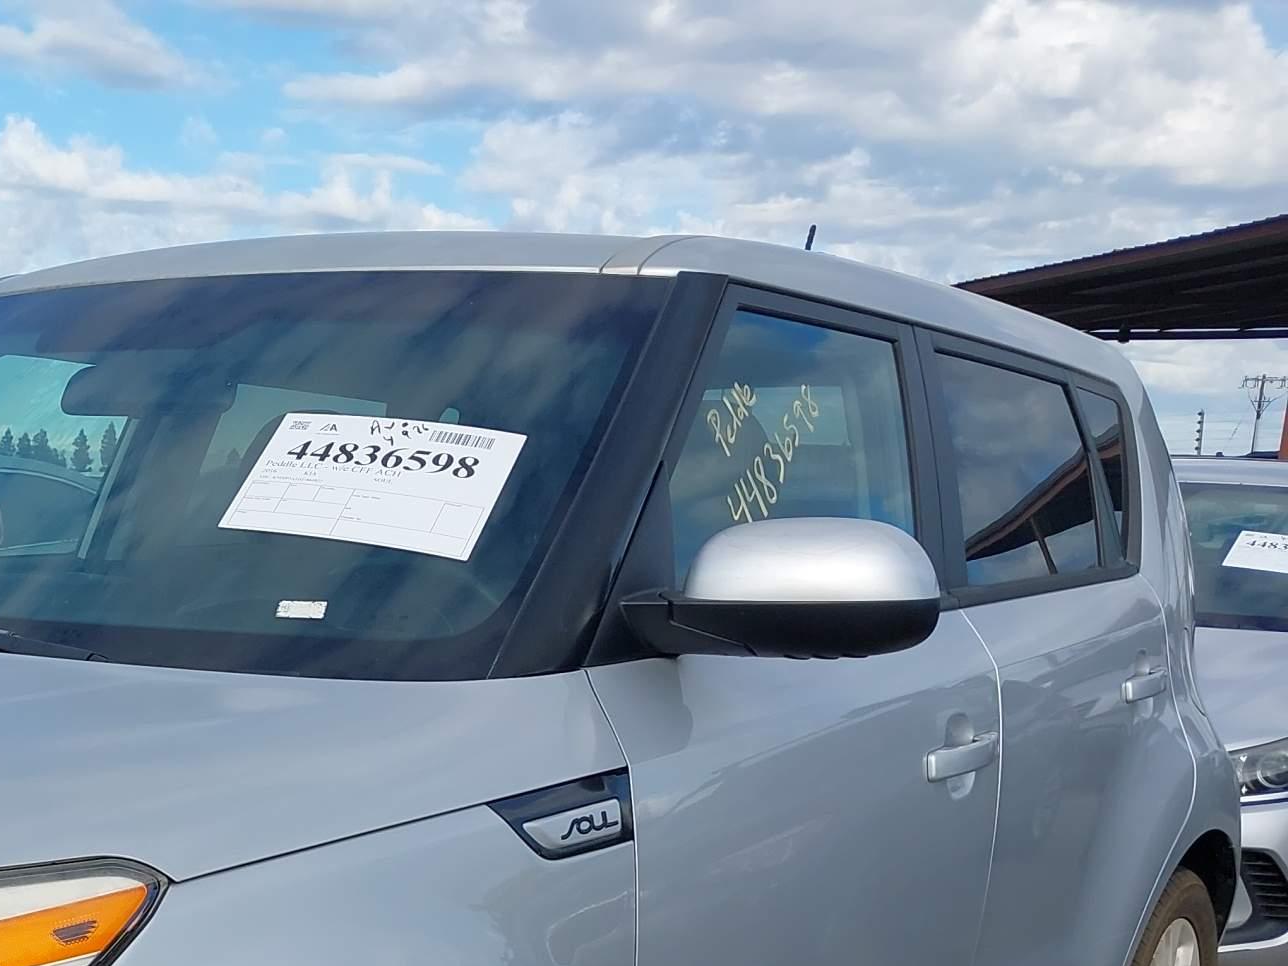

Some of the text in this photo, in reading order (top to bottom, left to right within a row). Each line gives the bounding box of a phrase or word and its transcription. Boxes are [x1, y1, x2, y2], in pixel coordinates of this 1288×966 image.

[287, 440, 480, 479] 44836598
[727, 384, 820, 523] 44836598
[560, 810, 619, 840] SOUL
